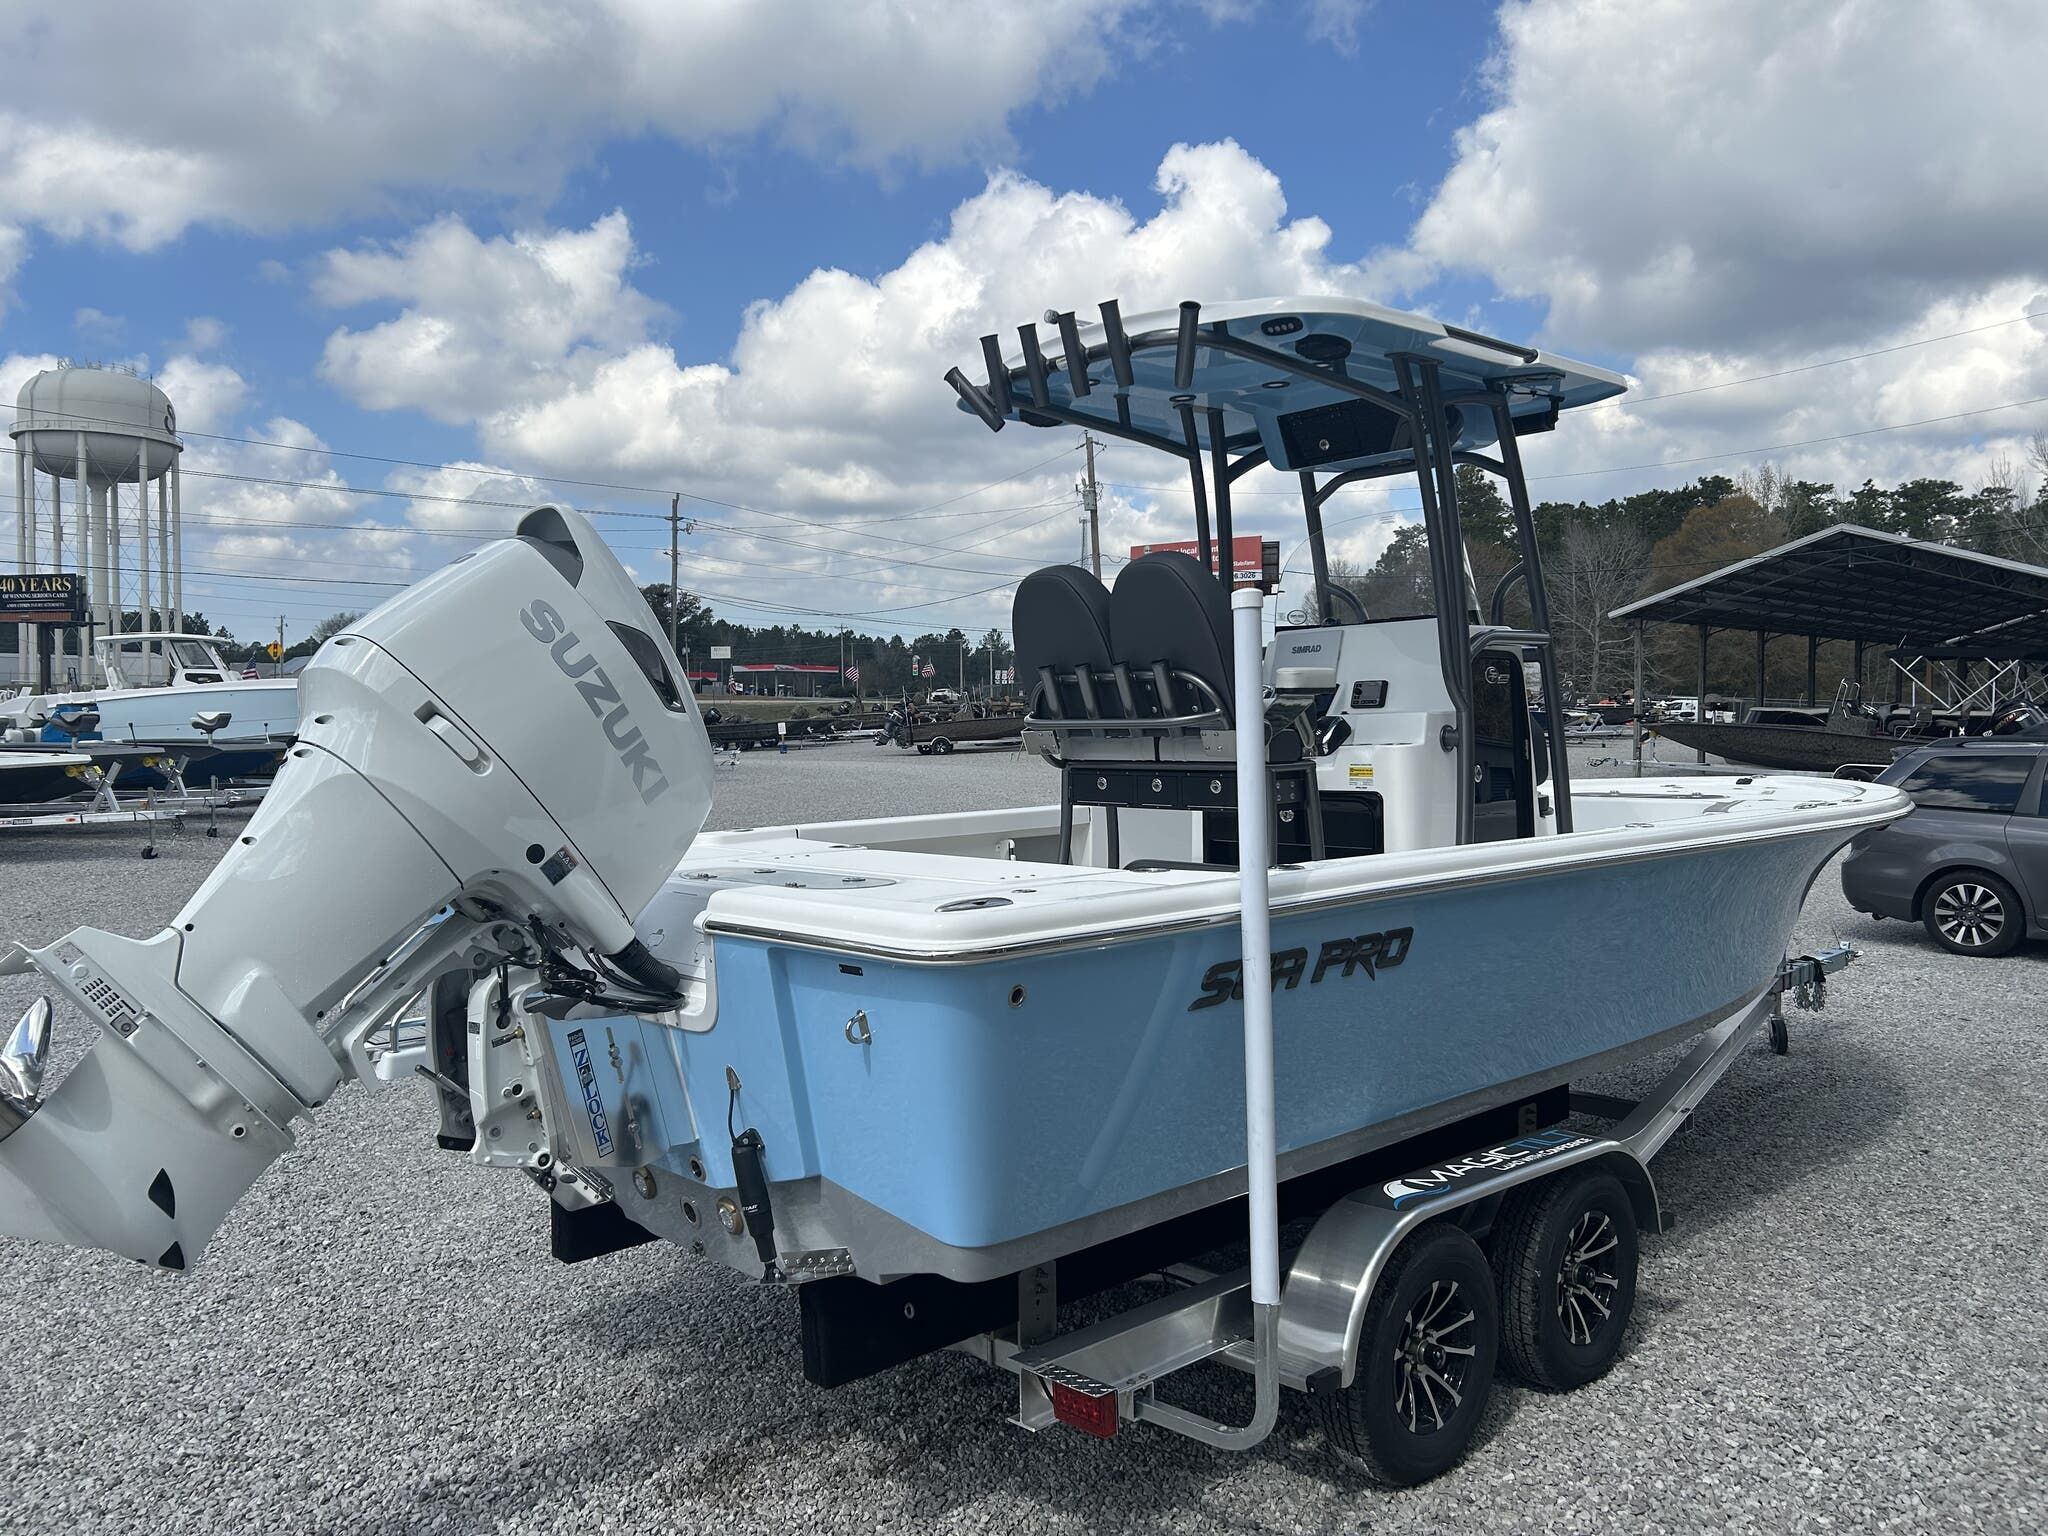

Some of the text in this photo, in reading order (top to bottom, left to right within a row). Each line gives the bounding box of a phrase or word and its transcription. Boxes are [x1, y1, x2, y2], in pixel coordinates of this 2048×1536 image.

[0, 576, 72, 593] 40 YEARS
[1291, 644, 1322, 655] SIMRAD
[519, 599, 670, 806] SUZUKI
[1310, 926, 1414, 985] PRO
